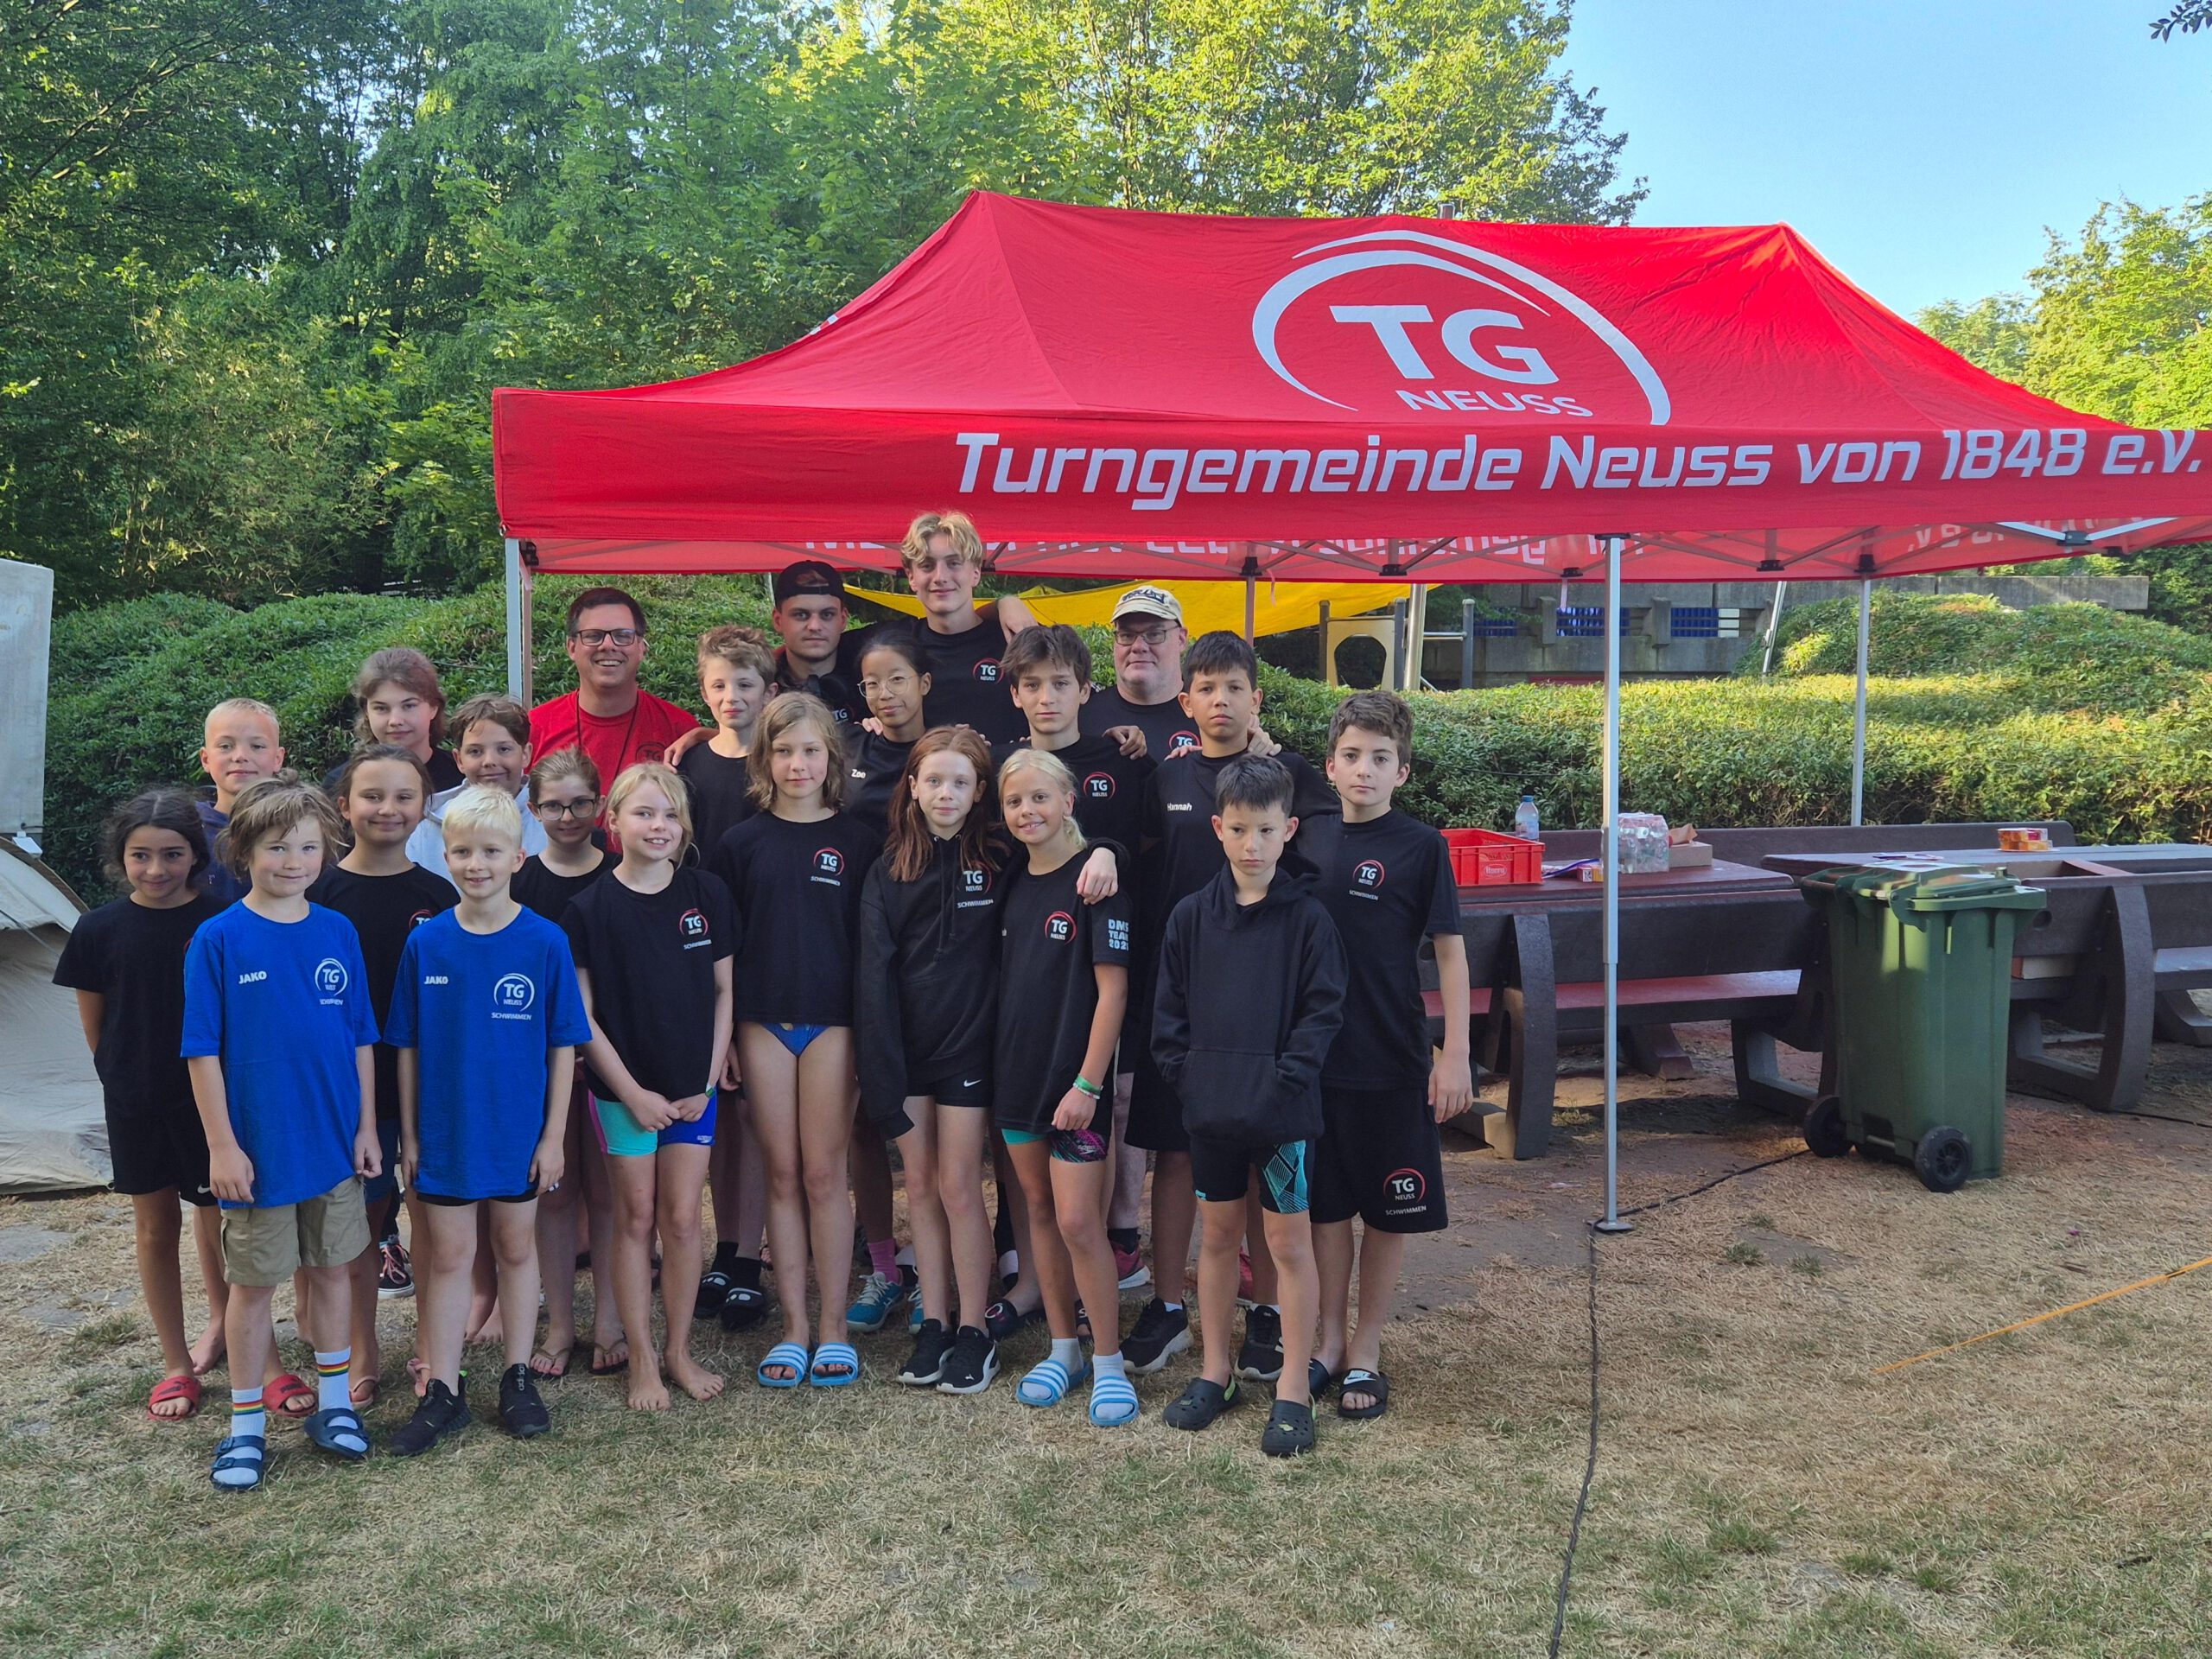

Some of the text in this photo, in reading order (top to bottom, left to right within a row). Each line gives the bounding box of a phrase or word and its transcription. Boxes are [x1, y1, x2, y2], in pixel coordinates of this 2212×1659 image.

[1329, 305, 1560, 385] TG
[1395, 390, 1593, 416] NEUSS
[956, 429, 2202, 510] Turngemeinde Neuss von 1848 e.V.
[980, 664, 996, 676] TG
[832, 709, 848, 721] TG
[1176, 736, 1192, 747] TG
[1090, 779, 1108, 791] TG
[1166, 802, 1192, 811] Hannah
[822, 853, 837, 867] TG
[963, 870, 983, 885] TG
[1362, 866, 1377, 880] TG
[684, 915, 702, 929] TG
[1052, 919, 1068, 934] TG
[238, 970, 267, 984] JAKO
[322, 968, 340, 983] TG
[423, 976, 448, 985] JAKO
[503, 983, 524, 999] TG
[491, 1012, 532, 1021] SCHWIMMEN
[1391, 1177, 1415, 1194] TG
[1395, 1192, 1415, 1201] NEUSS
[1385, 1205, 1427, 1216] SCHWIMMEN
